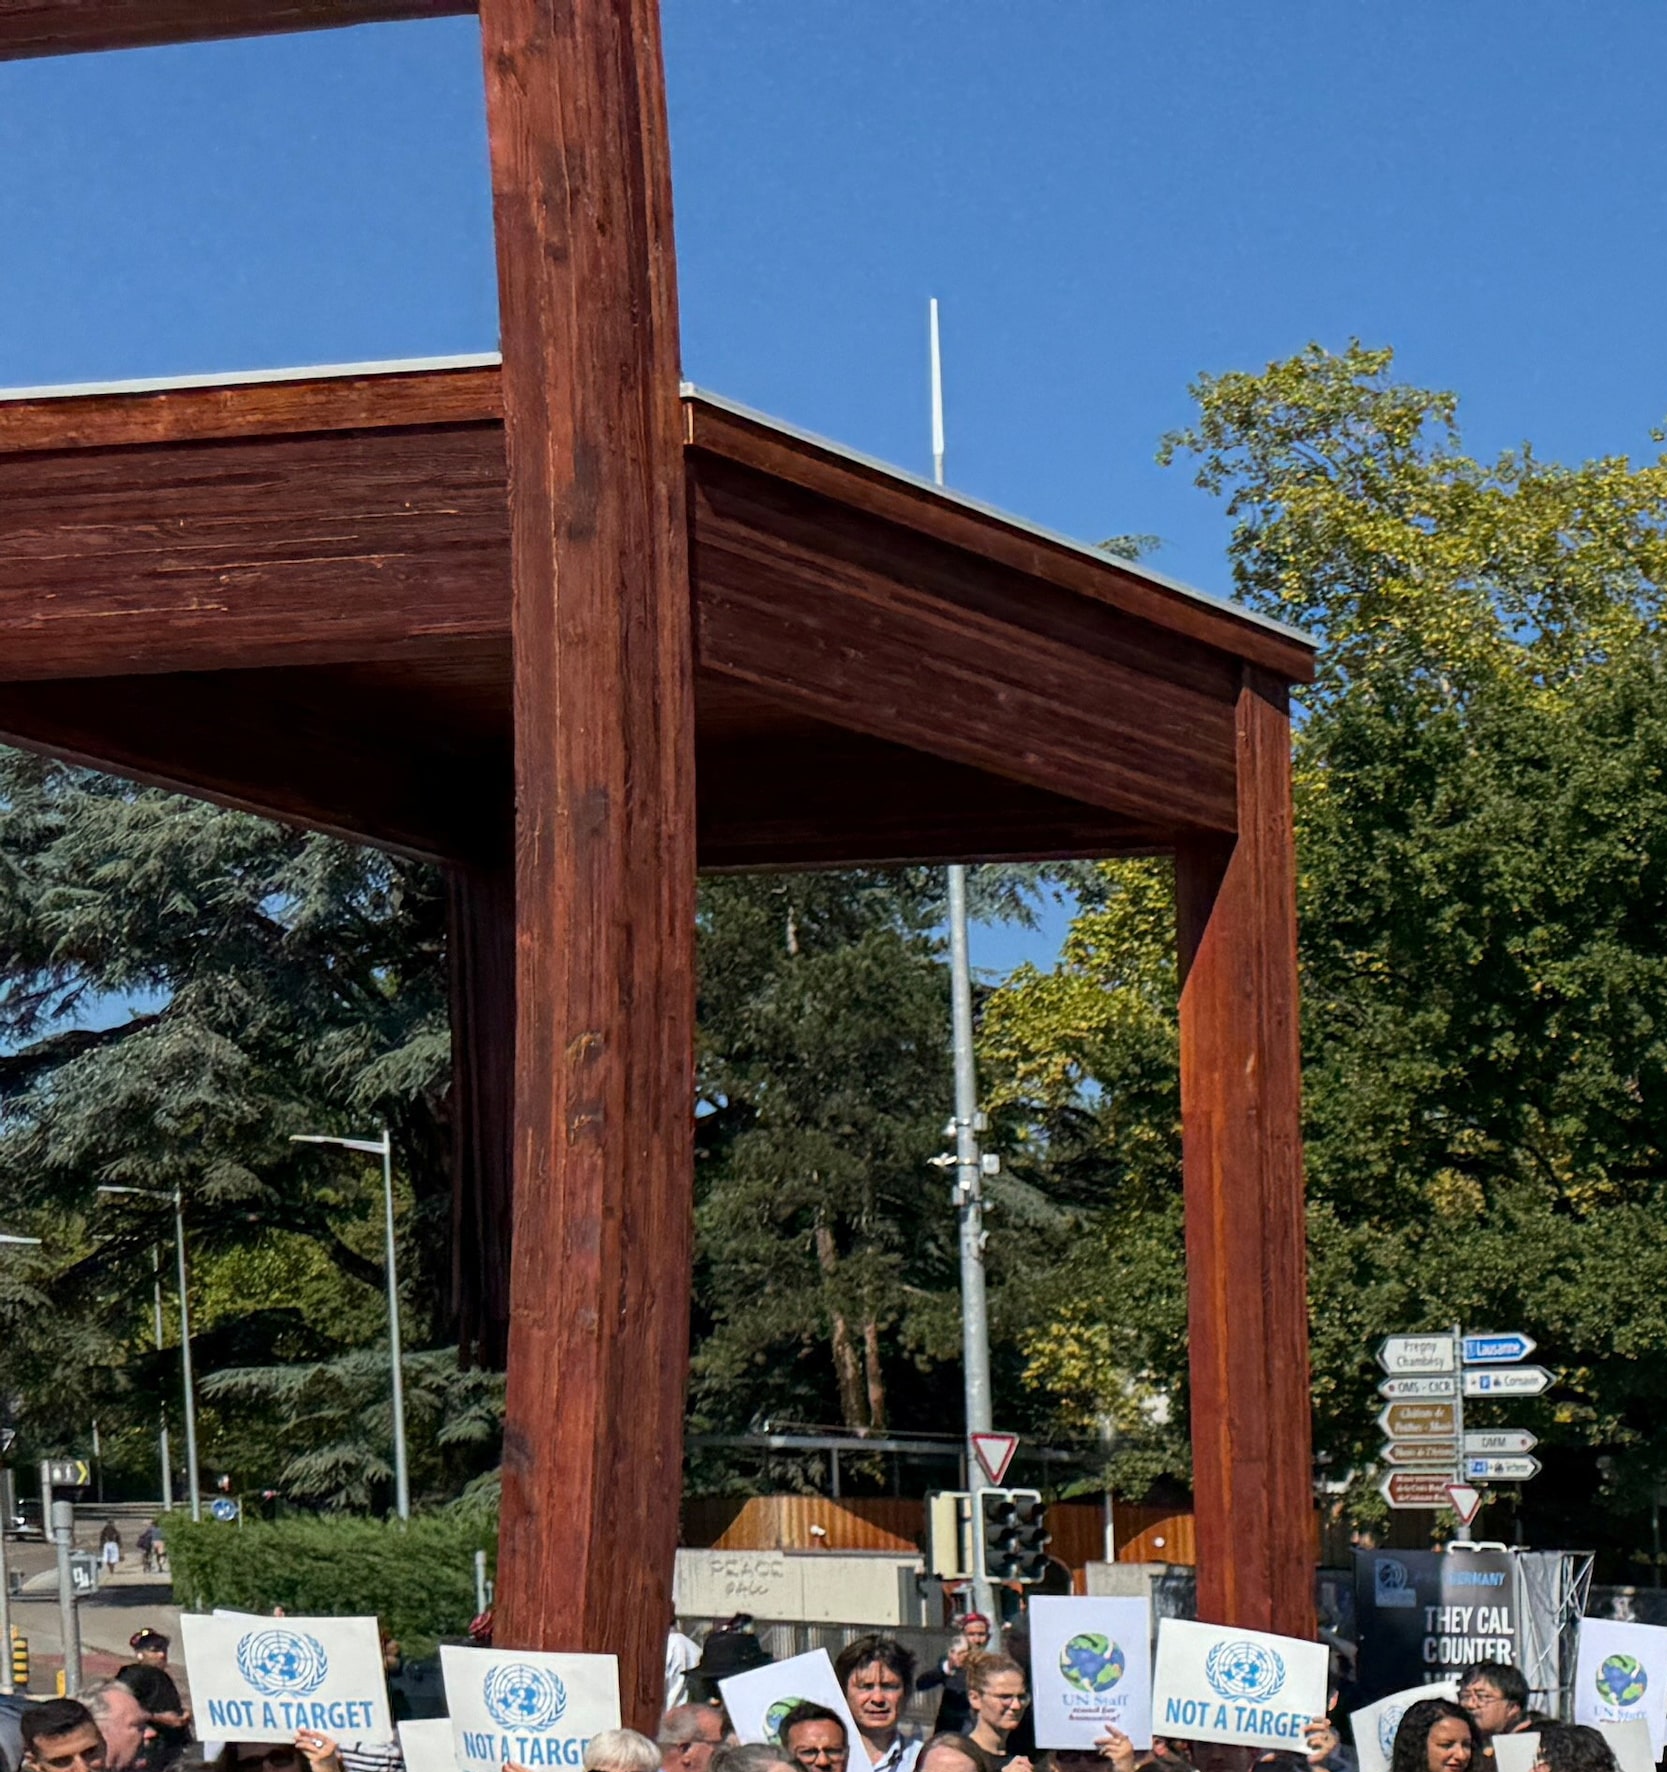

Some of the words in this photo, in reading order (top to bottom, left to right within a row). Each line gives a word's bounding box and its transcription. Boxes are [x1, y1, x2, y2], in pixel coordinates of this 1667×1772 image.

[1425, 1605, 1473, 1634] THEY
[1422, 1636, 1517, 1666] COUNTER-
[207, 1699, 254, 1728] NOT
[263, 1700, 278, 1729] A
[279, 1700, 374, 1730] TARGET
[1166, 1697, 1216, 1729] NOT
[1214, 1704, 1228, 1730] A
[463, 1731, 495, 1761] NOT
[501, 1736, 511, 1763] A
